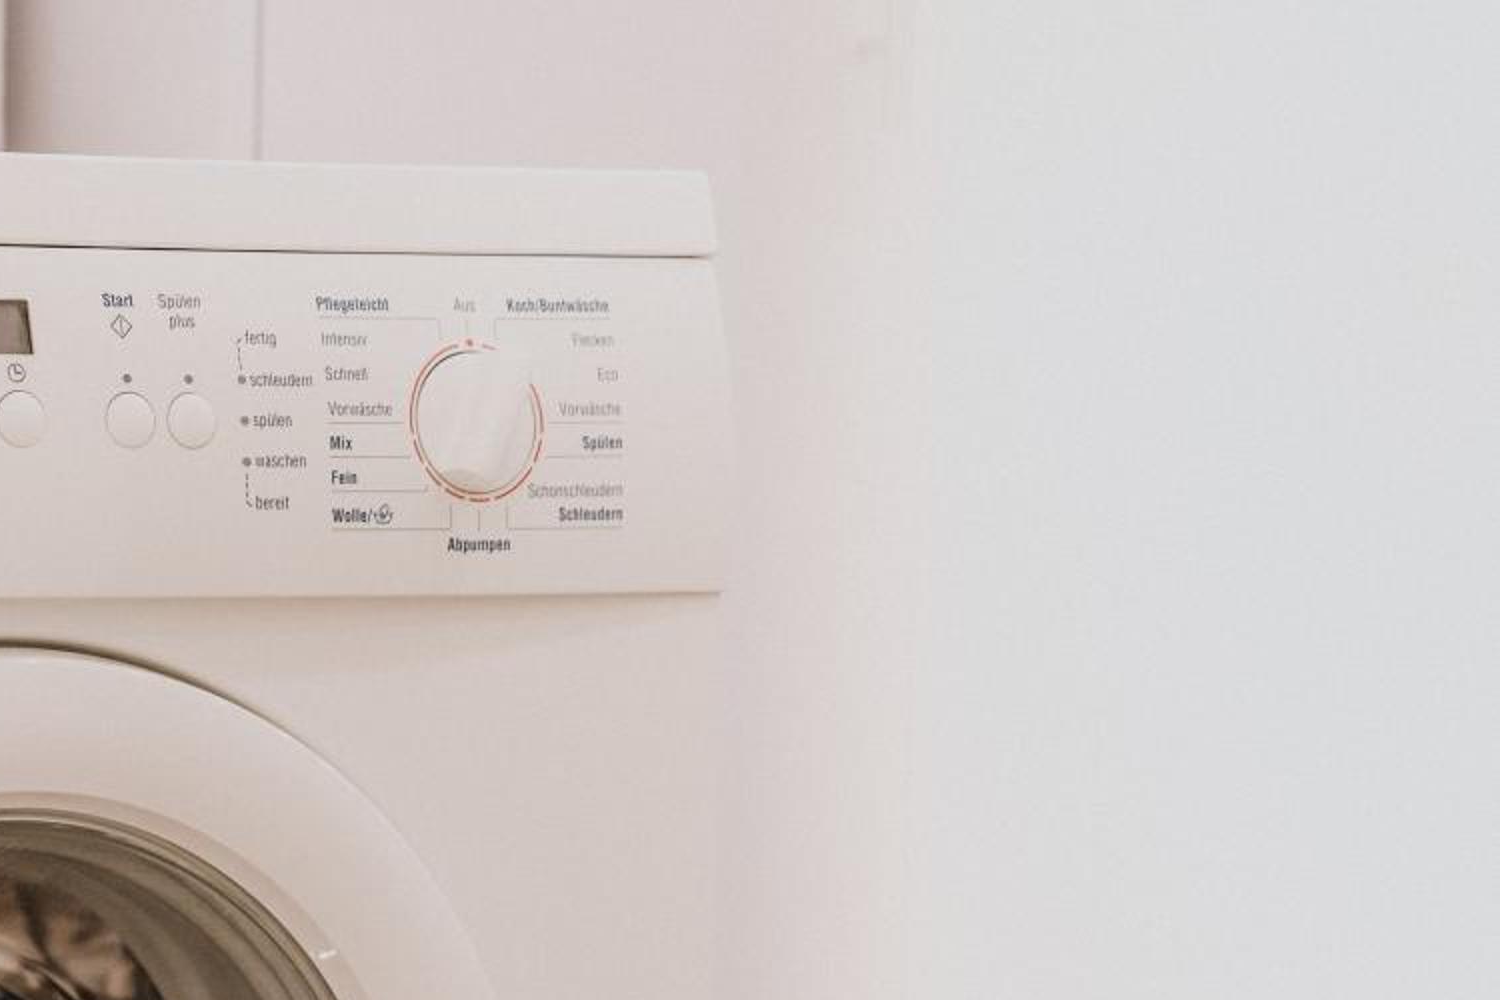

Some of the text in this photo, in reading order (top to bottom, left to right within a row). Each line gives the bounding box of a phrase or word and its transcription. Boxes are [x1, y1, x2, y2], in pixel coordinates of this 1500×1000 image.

[101, 293, 133, 307] Start
[157, 292, 201, 311] Spülen
[315, 296, 389, 313] Pflegeleicht
[453, 298, 476, 312] Aus
[506, 298, 609, 312] Koch/Buntwäsche
[169, 314, 196, 330] plus
[244, 330, 276, 348] fertig
[321, 332, 368, 346] Intensiv
[250, 372, 312, 387] schleudern
[325, 366, 368, 381] Schnell
[597, 368, 618, 382] Eco
[327, 401, 392, 416] Vorwäsche
[558, 401, 620, 416] Vorwäsche
[253, 412, 292, 428] spülen
[329, 435, 352, 450] Mix
[582, 435, 623, 451] Spülen
[256, 453, 306, 468] waschen
[331, 470, 357, 484] Fein
[528, 483, 623, 498] Schonschleudern
[255, 496, 289, 510] bereit
[559, 507, 623, 521] Schleudern
[448, 537, 511, 553] Abpumpen
